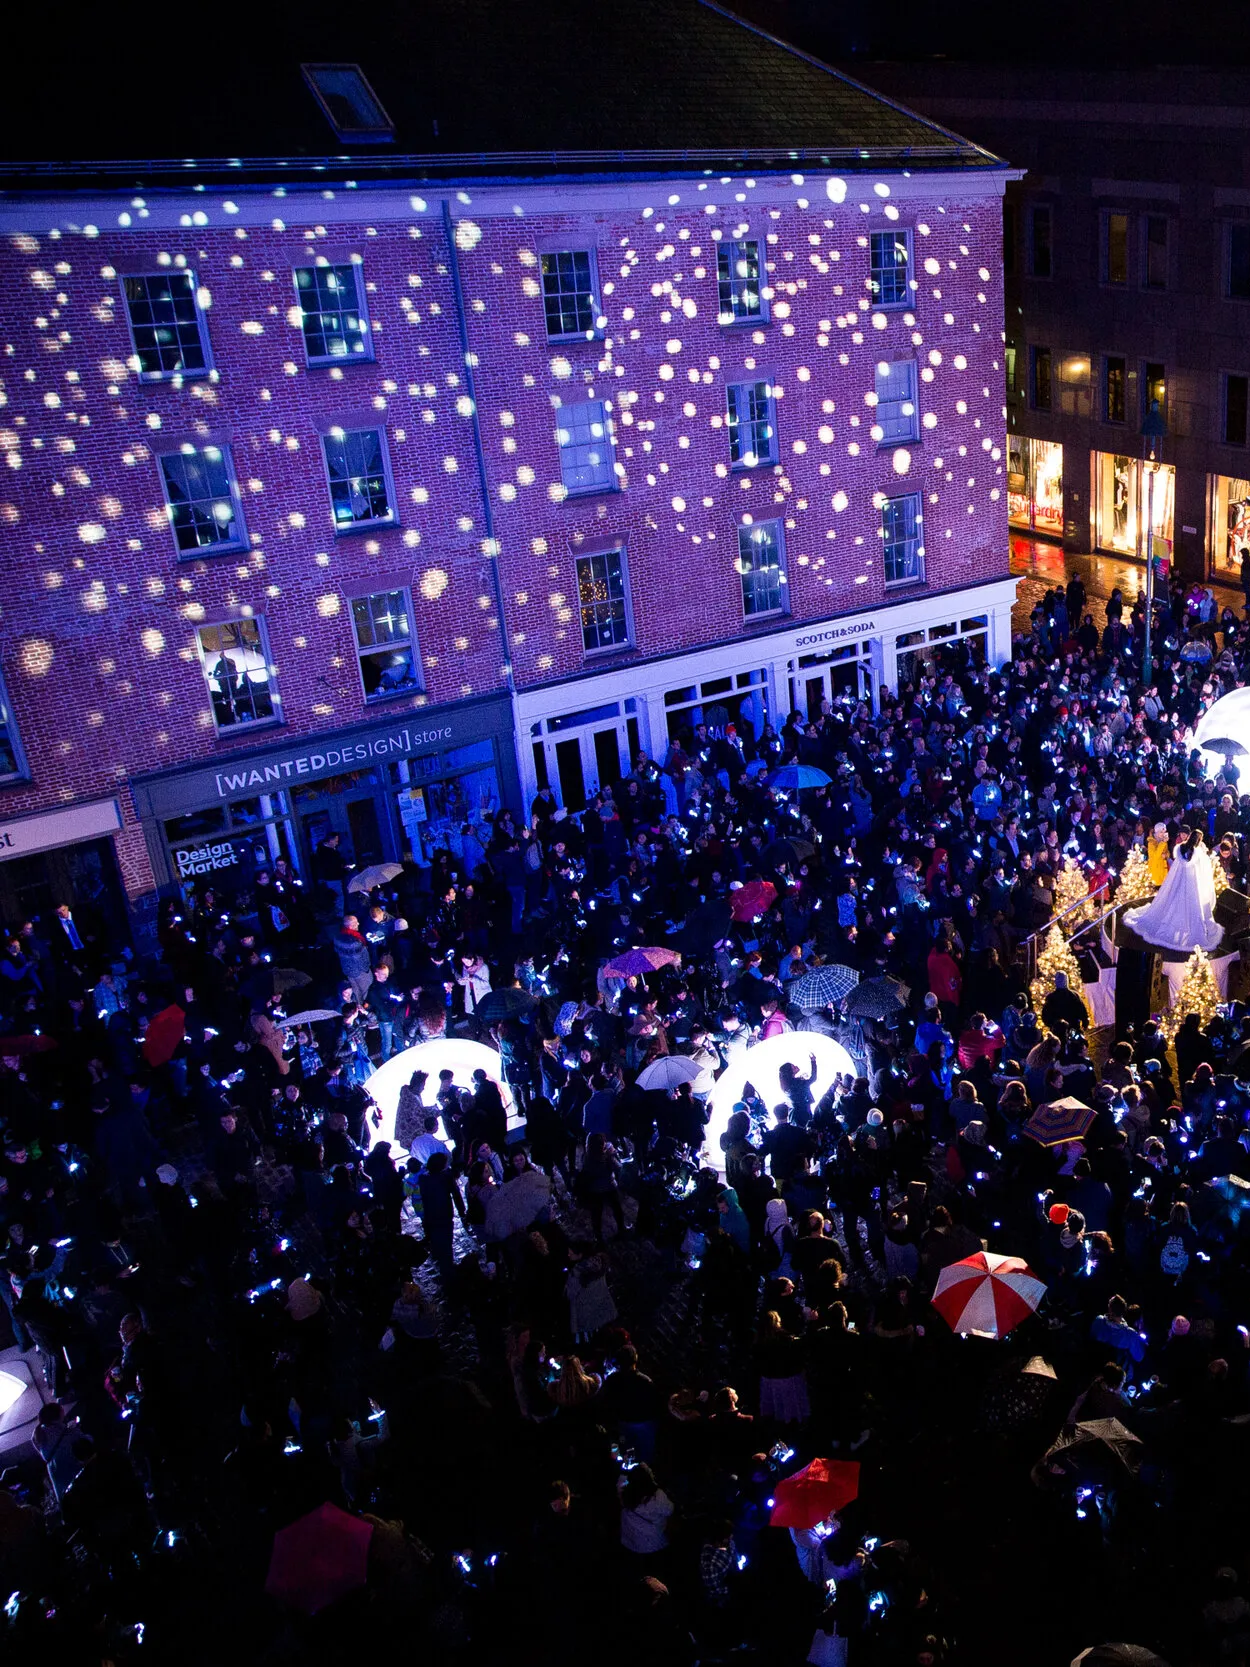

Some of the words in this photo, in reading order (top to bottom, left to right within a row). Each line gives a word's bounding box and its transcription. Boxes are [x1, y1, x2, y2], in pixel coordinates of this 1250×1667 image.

[796, 621, 875, 647] SCOTCH&SODA
[414, 727, 452, 746] store
[176, 843, 233, 864] Design
[180, 853, 239, 878] Market
